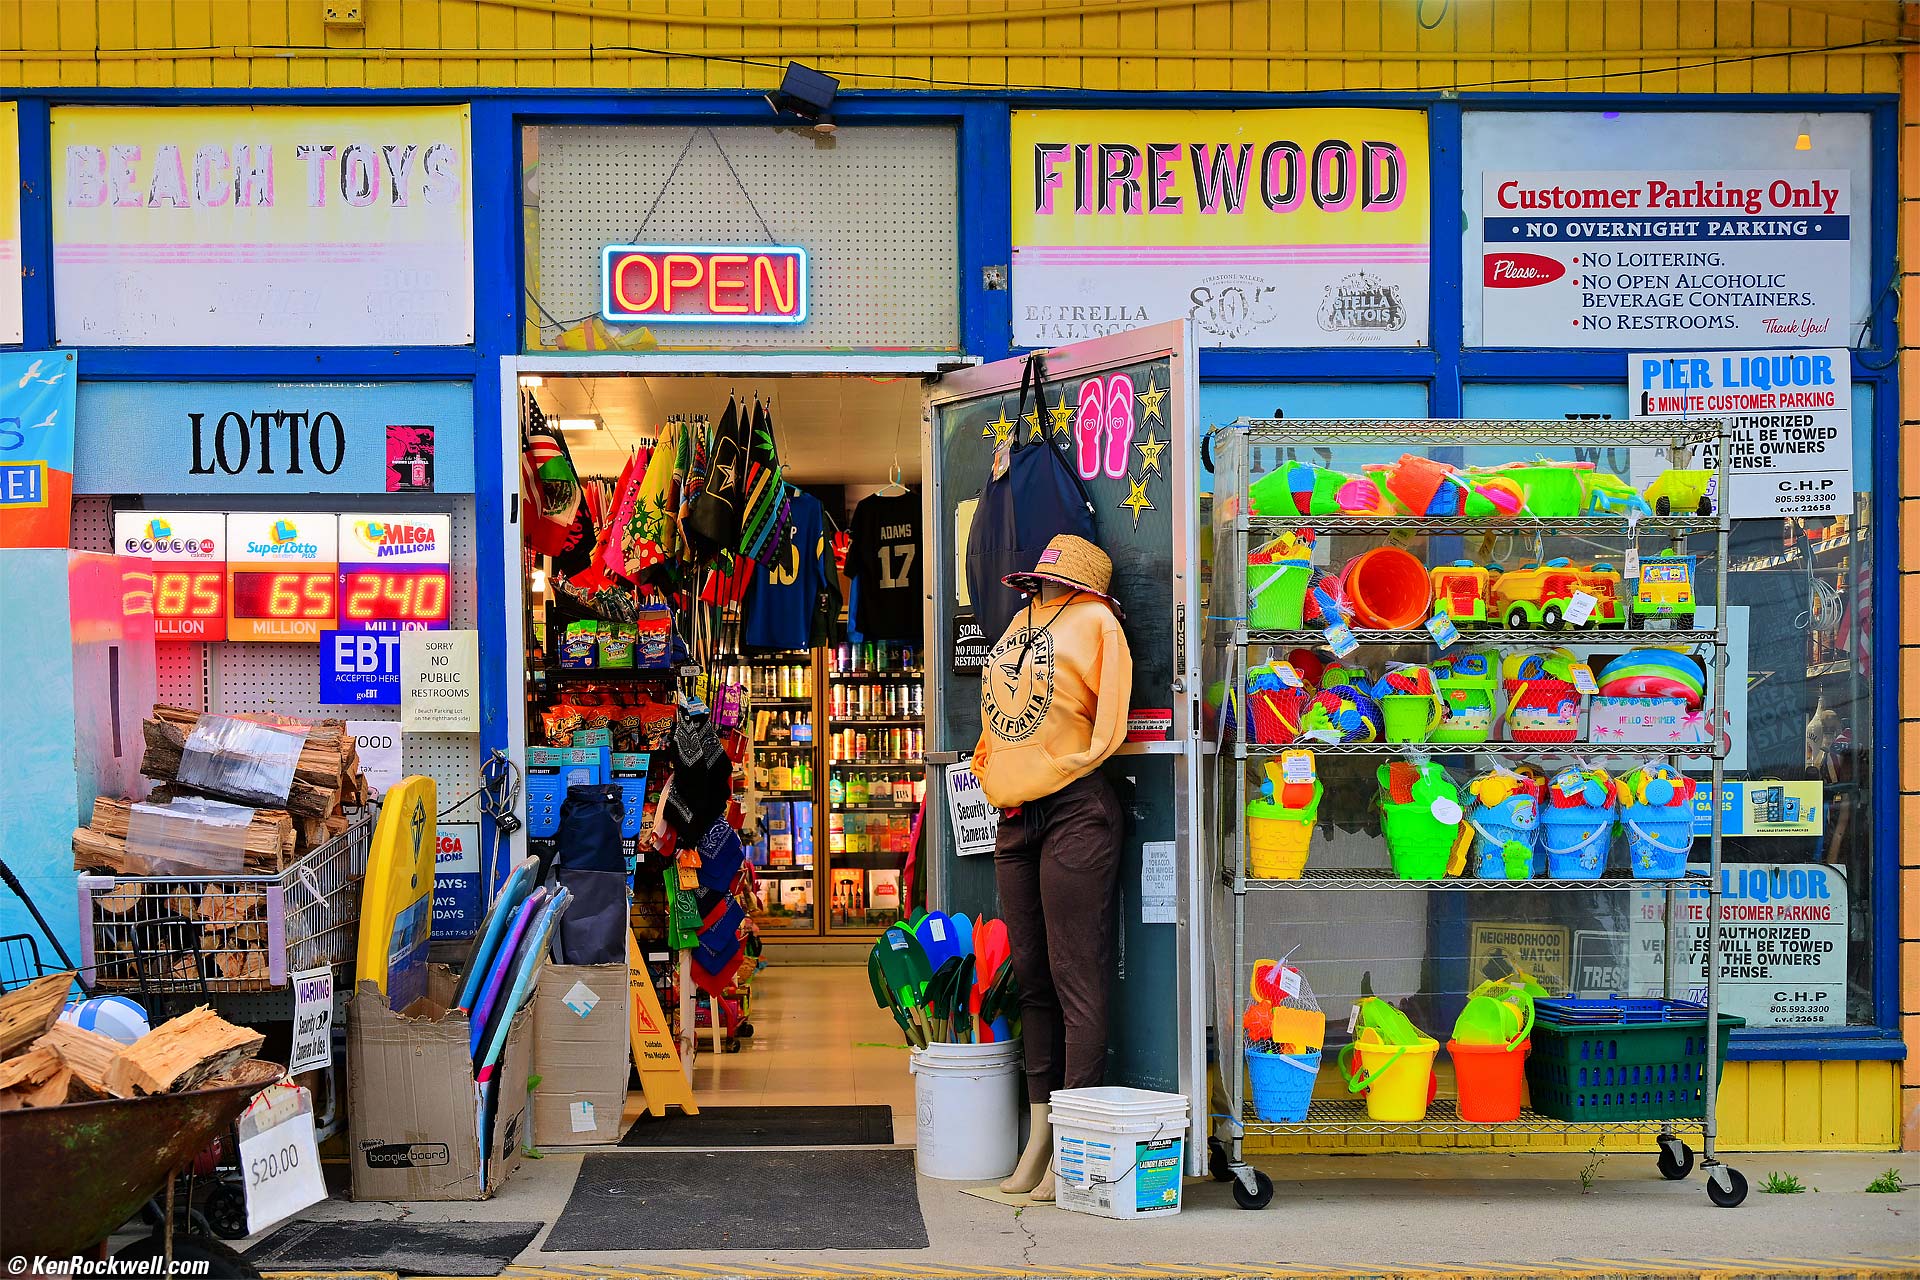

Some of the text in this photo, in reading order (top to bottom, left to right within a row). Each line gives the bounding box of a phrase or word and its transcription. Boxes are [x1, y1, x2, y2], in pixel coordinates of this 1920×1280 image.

[67, 143, 460, 208] BEACH TOYS
[1033, 139, 1407, 215] FIREWOOD
[1497, 179, 1839, 214] Customer Parking Only
[1526, 221, 1808, 238] NO OVERNIGHT PARKING
[1582, 252, 1725, 267] NO LOITERING.
[1493, 259, 1550, 280] Please...
[615, 254, 795, 313] OPEN
[1582, 274, 1785, 290] NO OPEN ALCOHOLIC
[1334, 296, 1390, 309] STELLA
[1582, 292, 1816, 308] BEVERAGE CONTAINERS.
[1025, 305, 1150, 321] ESTRELLA
[1333, 309, 1391, 322] ARTOIS
[1582, 315, 1739, 331] NO RESTROOMS.
[1762, 318, 1829, 337] Thank You!
[1642, 355, 1835, 390] PIER LIQUOR
[1659, 396, 1704, 412] MINUTE
[1708, 393, 1776, 411] CUSTOMER
[1779, 392, 1835, 409] PARKING
[188, 409, 346, 475] LOTTO
[1732, 427, 1838, 442] ILL BE TOWED
[1760, 441, 1825, 455] OWNERS
[0, 469, 35, 499] E!
[1778, 480, 1834, 491] C.H.P
[1775, 493, 1836, 504] 805.593.3300
[1801, 504, 1831, 512] 22658
[380, 523, 435, 545] MEGA
[880, 524, 912, 540] ADAMS
[246, 541, 318, 557] SuperLotto
[377, 544, 435, 557] MILLIONS
[878, 544, 916, 589] 17
[269, 575, 331, 615] 65
[350, 576, 446, 616] 240
[154, 620, 204, 634] ILLION
[253, 621, 316, 634] MILLION
[1177, 609, 1185, 657] PUSH
[335, 636, 399, 672] EBT
[425, 642, 454, 650] SORRY
[955, 645, 990, 655] NO PUBLIC
[431, 656, 449, 666] NO
[335, 674, 399, 683] ACCEPTED HERE
[420, 673, 461, 683] PUBLIC
[411, 688, 470, 698] RESTROOMS
[985, 693, 1045, 734] CALIFORNIA
[1619, 716, 1676, 725] HELLO SUMMER
[355, 735, 392, 748] OOD
[957, 800, 986, 820] Security
[1697, 803, 1732, 811] GAES
[961, 826, 989, 843] Cameras
[436, 837, 463, 854] EGA
[436, 853, 463, 864] LIONS
[1721, 869, 1830, 903] LIQUOR
[1777, 905, 1831, 921] PARKING
[1480, 932, 1560, 946] NEIGHBORHOOD
[1757, 940, 1775, 952] BE
[1776, 940, 1833, 952] TOWED
[1520, 949, 1560, 962] WATCH
[1726, 952, 1821, 965] THE OWNERS
[1533, 964, 1545, 973] ALL
[1701, 967, 1773, 978] EPENSE.
[1583, 966, 1622, 989] TRES
[301, 979, 330, 1003] WARNING
[1773, 991, 1827, 1001] C.H.P
[1769, 1005, 1829, 1013] 805.593.3300
[299, 1013, 317, 1036] Security
[296, 1041, 312, 1062] Cameras
[317, 1036, 326, 1055] Use
[251, 1143, 299, 1189] $20.00
